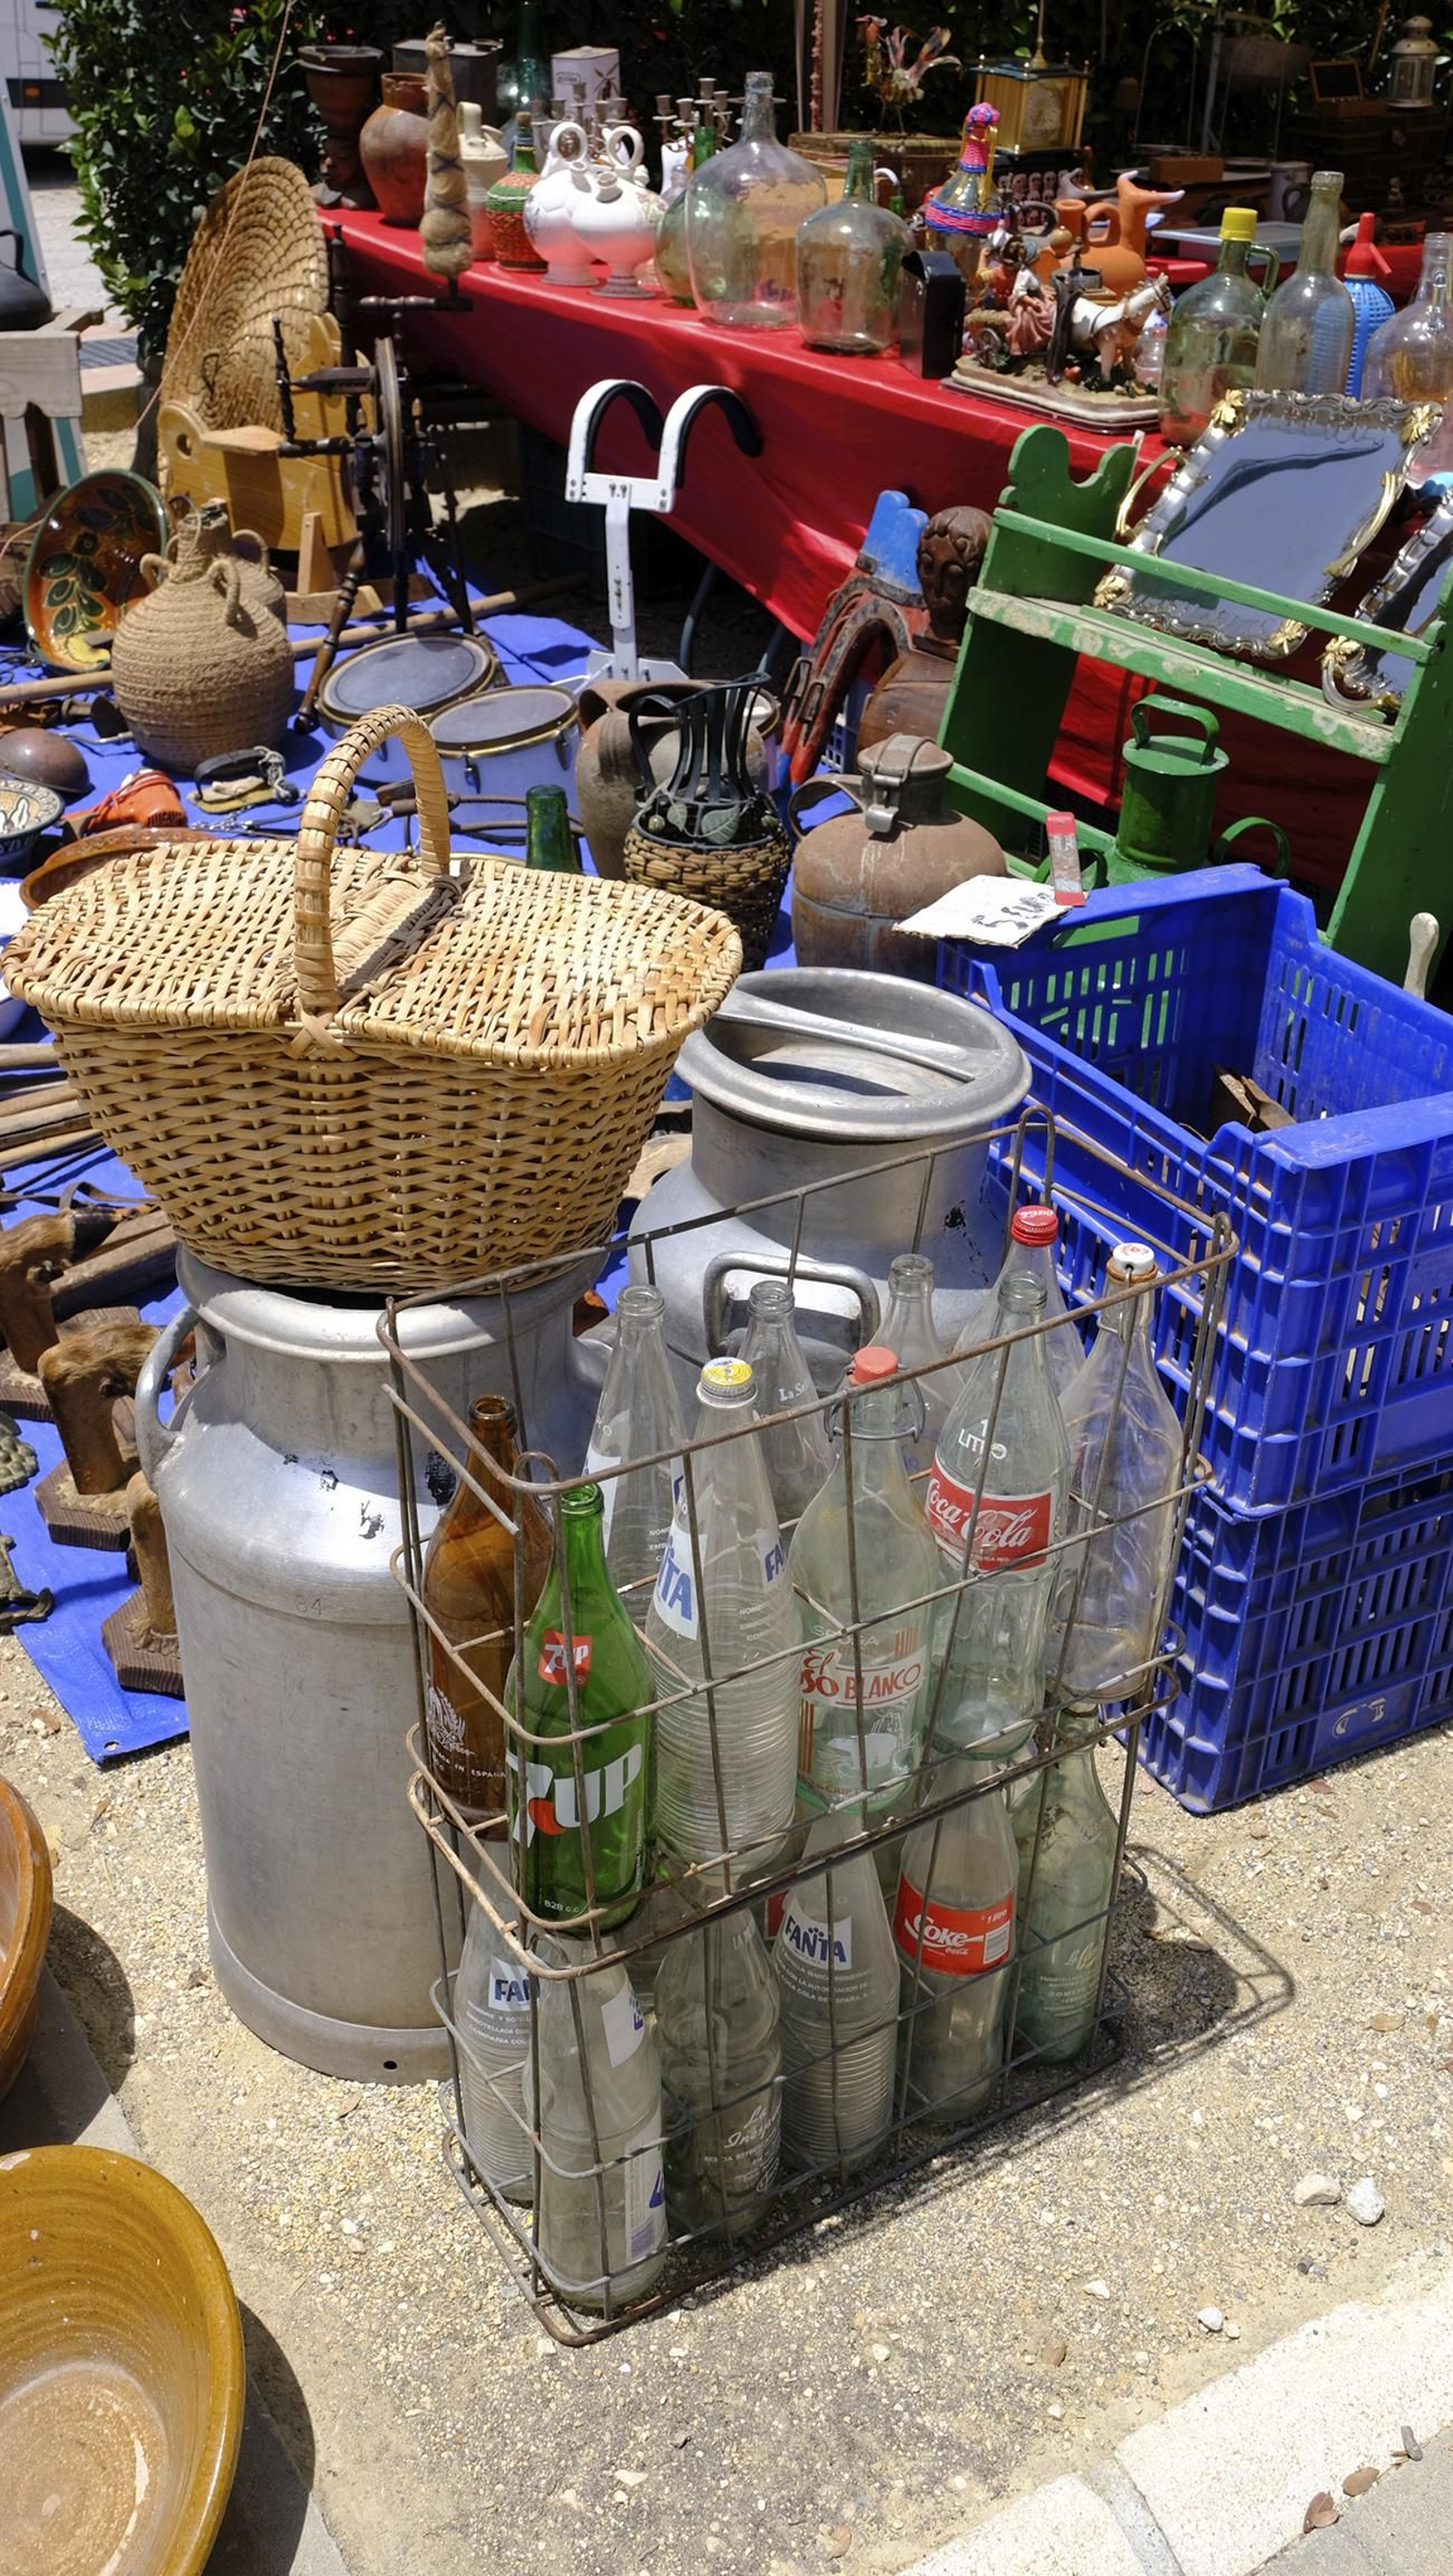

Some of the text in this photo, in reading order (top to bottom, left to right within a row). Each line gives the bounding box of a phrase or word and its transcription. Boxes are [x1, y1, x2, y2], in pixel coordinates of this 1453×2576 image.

[924, 1477, 1038, 1548] Coca-Cola
[844, 1663, 922, 1700] BLANCO
[505, 1742, 643, 1850] 7UP
[785, 1914, 847, 1963] FANTA
[913, 1912, 969, 1949] Coke
